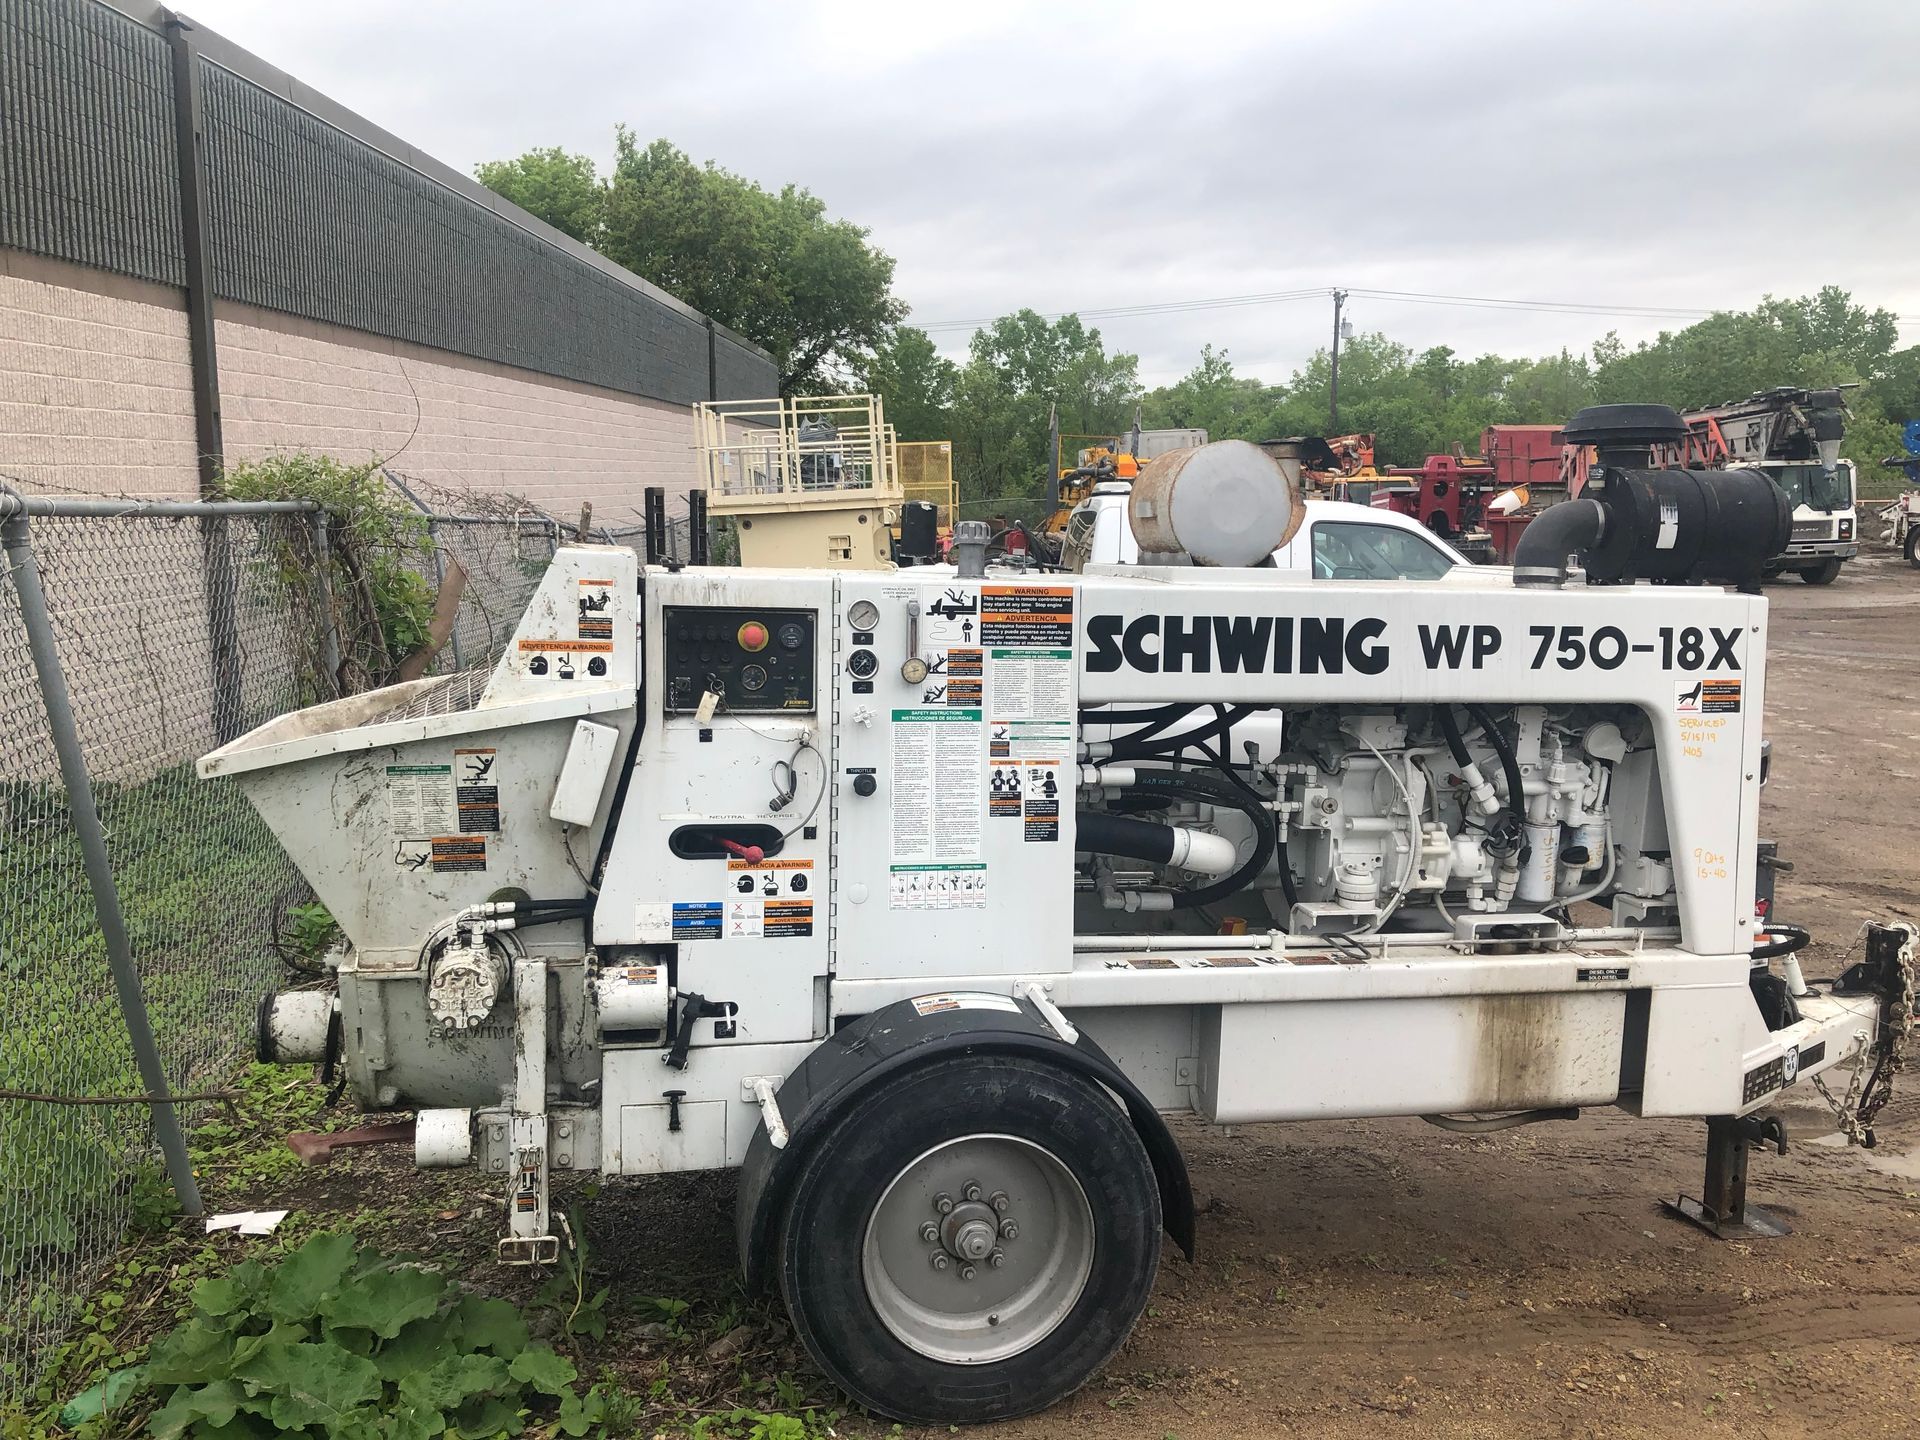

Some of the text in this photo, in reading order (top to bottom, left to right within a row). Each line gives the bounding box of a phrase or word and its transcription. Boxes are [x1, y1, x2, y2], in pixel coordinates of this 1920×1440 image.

[1086, 614, 1744, 675] SCHWING WP 750-18X
